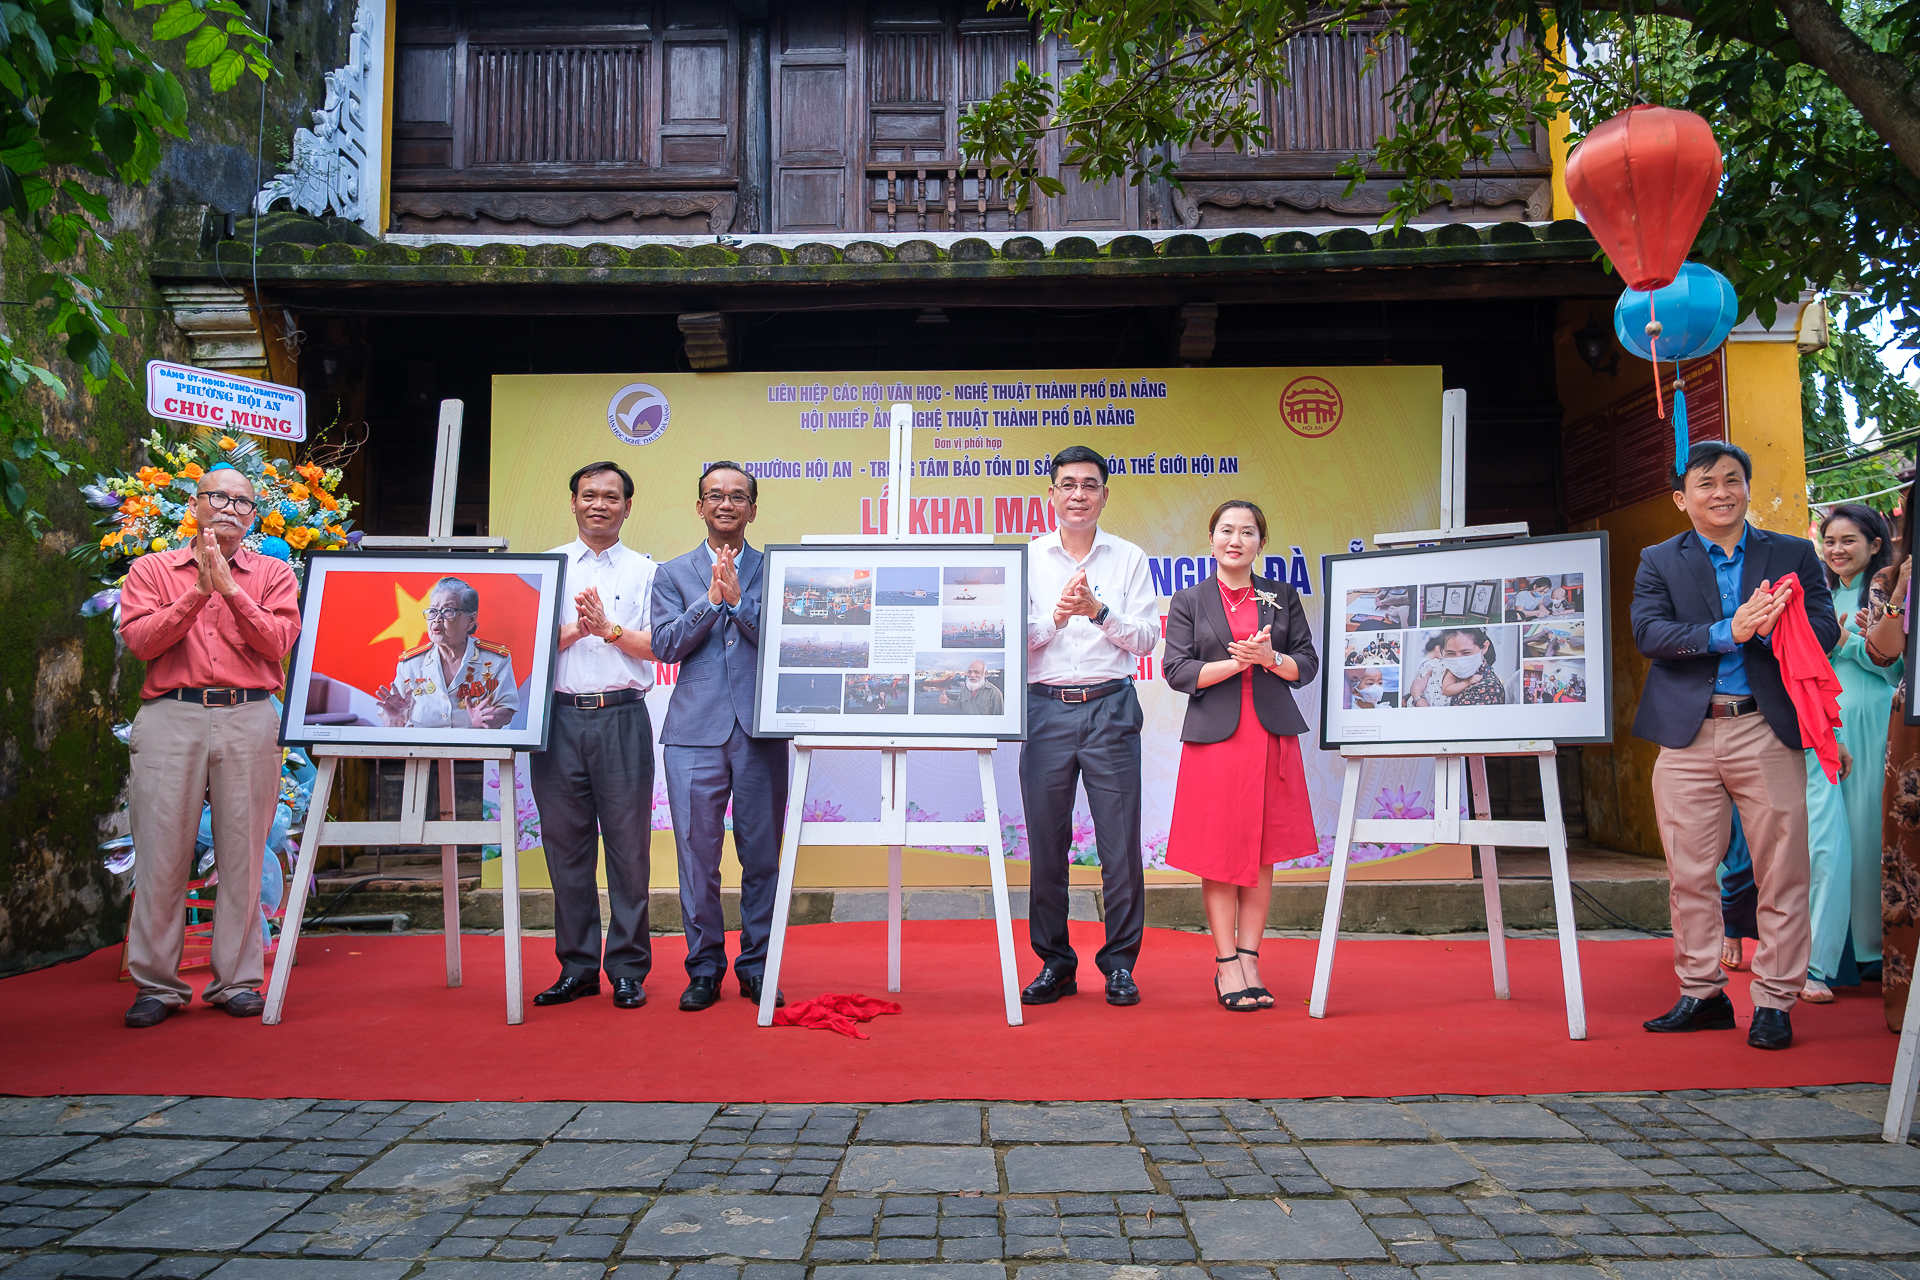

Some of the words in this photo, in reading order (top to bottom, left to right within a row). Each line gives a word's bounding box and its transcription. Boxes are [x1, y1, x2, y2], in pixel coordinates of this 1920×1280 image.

[177, 382, 234, 402] PHƯỜNG
[237, 394, 261, 410] HỘI
[264, 400, 281, 411] AN
[768, 383, 796, 402] LIÊN
[800, 383, 829, 405] HIỆP
[833, 382, 859, 402] CÁC
[862, 382, 883, 404] HỘI
[887, 382, 913, 401] VĂN
[917, 385, 942, 404] HỌC
[954, 381, 989, 403] NGHỆ
[992, 381, 1031, 403] THUẬT
[1035, 380, 1077, 399] THÀNH
[1080, 378, 1107, 399] PHỐ
[1109, 380, 1127, 398] ĐÀ
[1130, 377, 1167, 398] NẴNG
[164, 398, 223, 421] CHÚC
[231, 409, 292, 434] MỪNG
[608, 414, 616, 428] VĂN
[613, 427, 625, 440] HỌC
[801, 409, 824, 432] HỘI
[827, 406, 869, 429] NHIẾP
[872, 406, 891, 428] ẢN
[946, 408, 989, 431] THUẬT
[992, 407, 1038, 427] THÀNH
[1042, 404, 1070, 426] PHỐ
[1073, 407, 1092, 426] ĐÀ
[1096, 403, 1135, 425] NẴNG
[934, 437, 951, 449] Đơn
[954, 438, 962, 450] vị
[964, 435, 983, 450] phối
[985, 437, 1002, 450] hợp
[745, 457, 801, 479] PHƯỜNG
[805, 457, 829, 482] HỘI
[832, 461, 852, 478] AN
[919, 457, 949, 477] TÂM
[953, 454, 981, 477] BẢO
[985, 454, 1012, 477] TỒN
[1015, 459, 1030, 476] DI
[1034, 453, 1051, 476] SẢ
[1103, 454, 1127, 474] ÓA
[1130, 452, 1156, 474] THẾ
[1160, 453, 1188, 474] GIỚI
[1191, 454, 1215, 477] HỘI
[1218, 457, 1239, 474] AN
[909, 496, 984, 534] KHAI
[1264, 546, 1313, 596] ĐÀ
